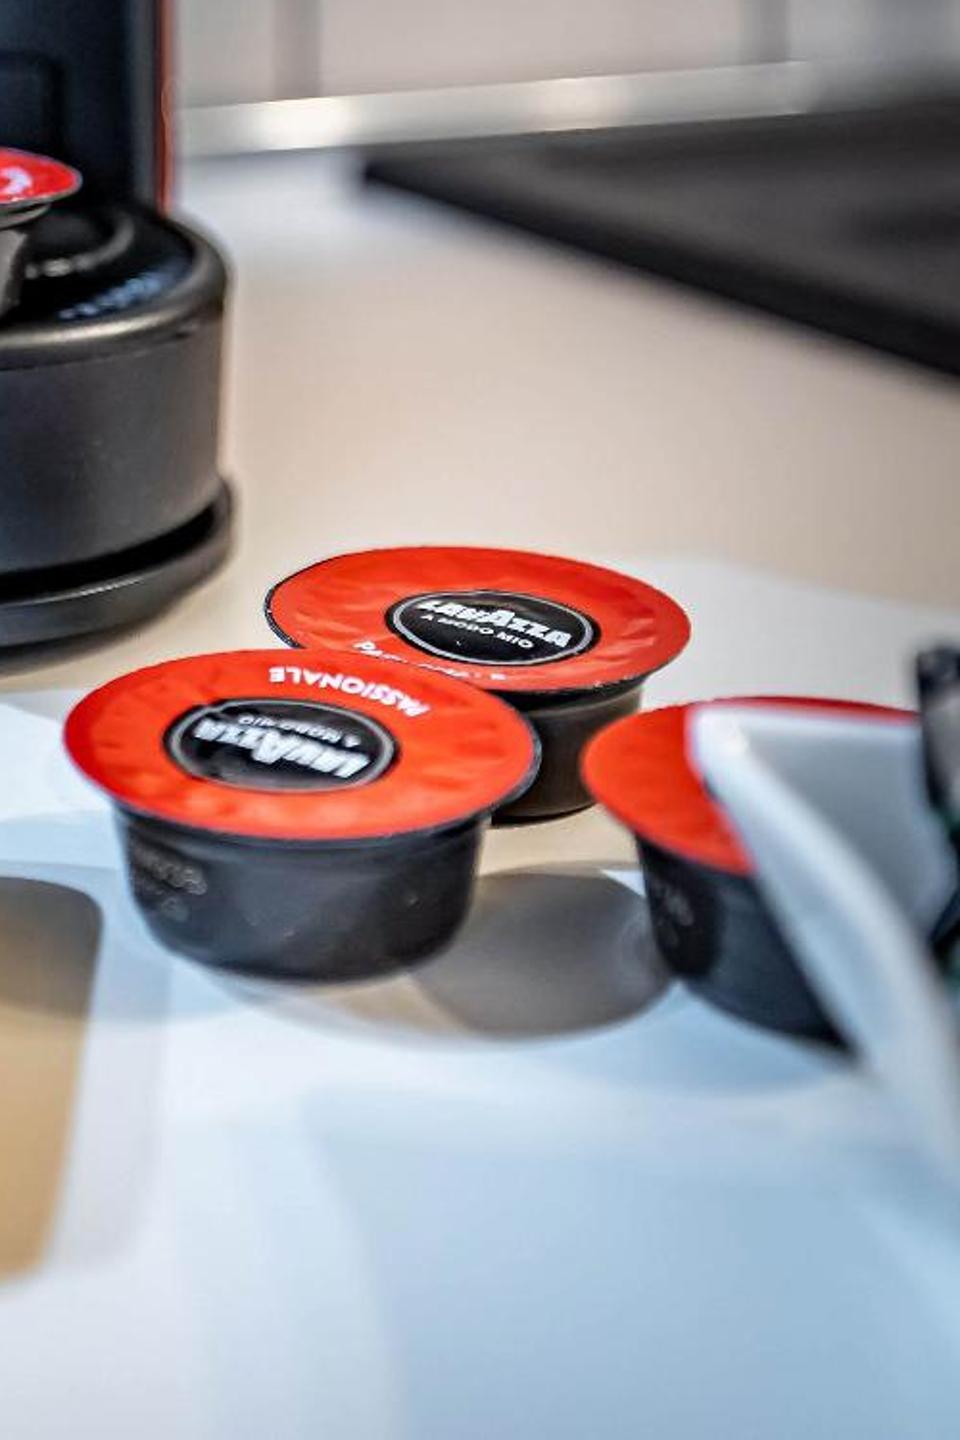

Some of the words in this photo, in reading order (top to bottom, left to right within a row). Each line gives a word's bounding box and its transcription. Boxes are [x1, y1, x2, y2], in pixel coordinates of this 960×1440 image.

[417, 600, 572, 648] LAVAZZA
[437, 617, 494, 636] MODO
[496, 631, 534, 649] MIO
[268, 666, 431, 718] PASSIONALE
[193, 718, 370, 779] LAVAZZA
